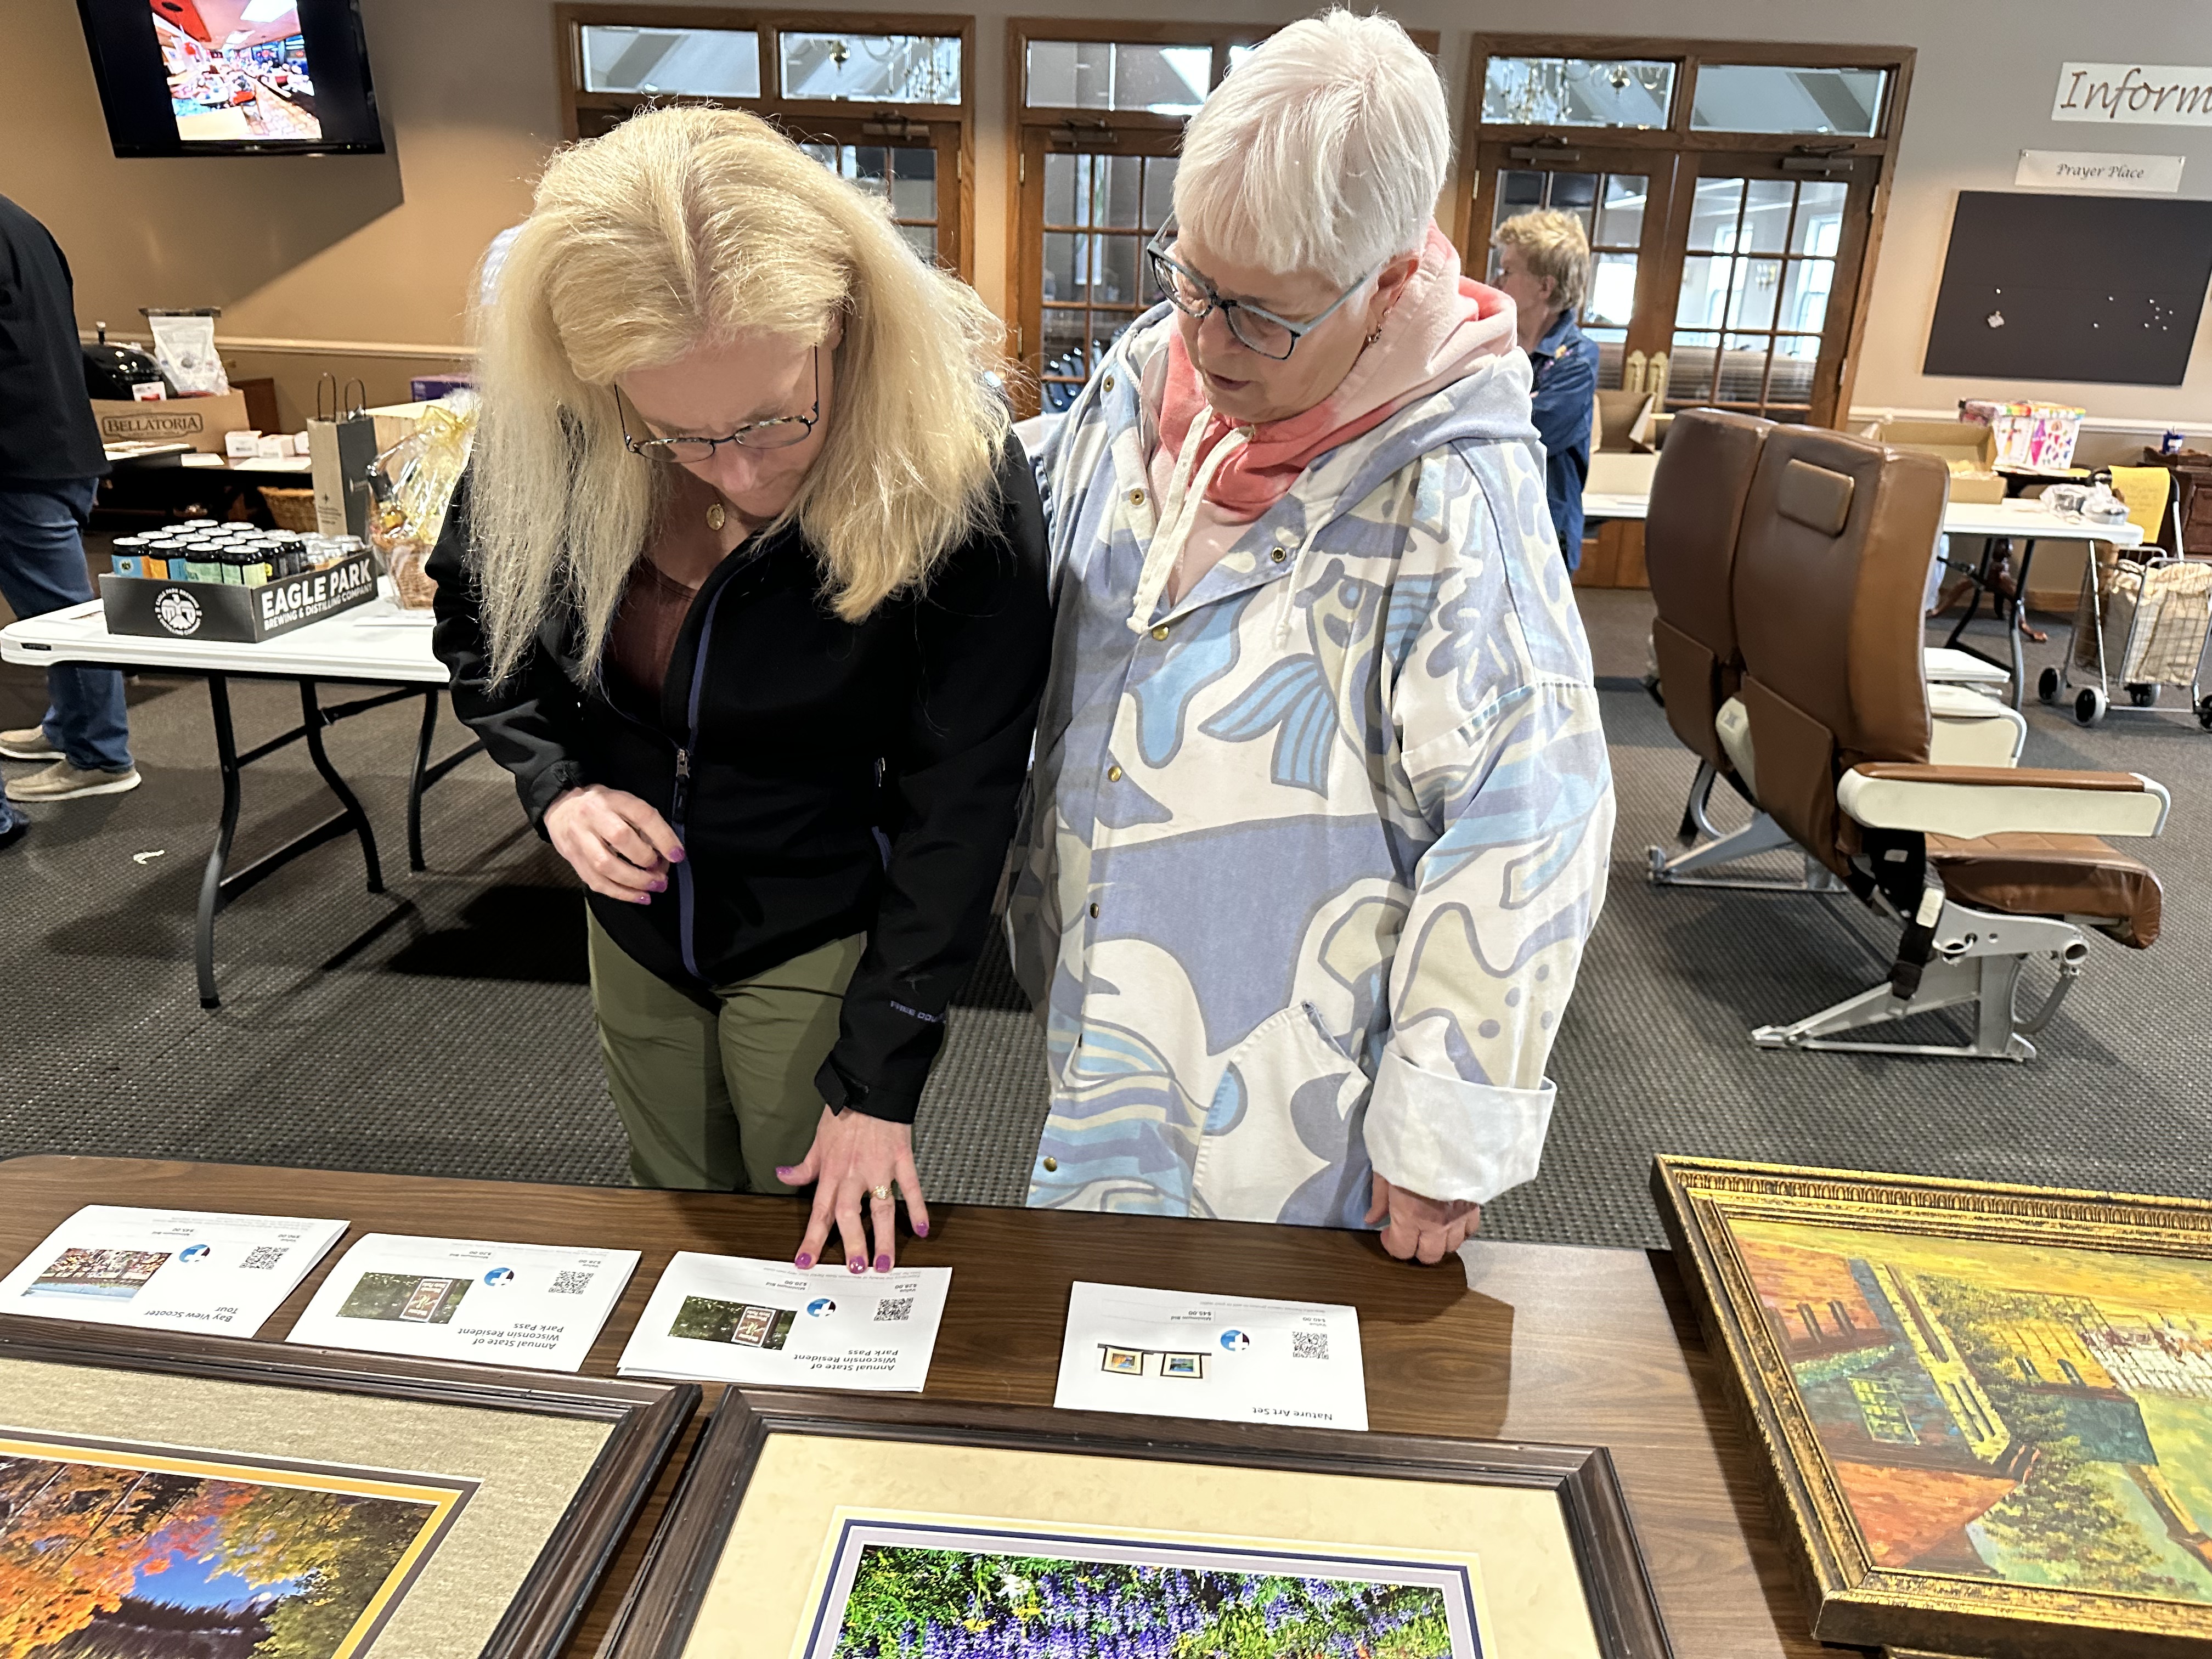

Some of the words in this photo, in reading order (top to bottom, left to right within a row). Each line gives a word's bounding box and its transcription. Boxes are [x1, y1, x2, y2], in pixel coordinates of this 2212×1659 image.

[2060, 67, 2212, 119] Inform
[2056, 163, 2105, 180] Prayer
[2108, 165, 2145, 179] Place
[261, 575, 326, 619] EAGLE
[330, 558, 372, 597] PARK
[264, 610, 298, 631] BREWING
[298, 608, 304, 619] &
[306, 594, 341, 616] DISTILLING
[342, 583, 373, 602] COMPANY
[144, 1310, 185, 1318] Scooter
[185, 1312, 211, 1321] View
[213, 1313, 233, 1322] Bay
[514, 1322, 537, 1331] Pass
[539, 1324, 564, 1333] Park
[457, 1328, 504, 1338] Resident
[506, 1330, 560, 1341] Wisconsin
[471, 1338, 484, 1346] of
[485, 1338, 515, 1347] State
[517, 1340, 556, 1350] Annual
[874, 1349, 899, 1357] Park
[793, 1354, 839, 1362] Resident
[843, 1356, 896, 1364] Wisconsin
[825, 1363, 854, 1372] State
[1251, 1407, 1270, 1415] Set
[1272, 1408, 1290, 1418] Art
[1293, 1410, 1333, 1421] Nature
